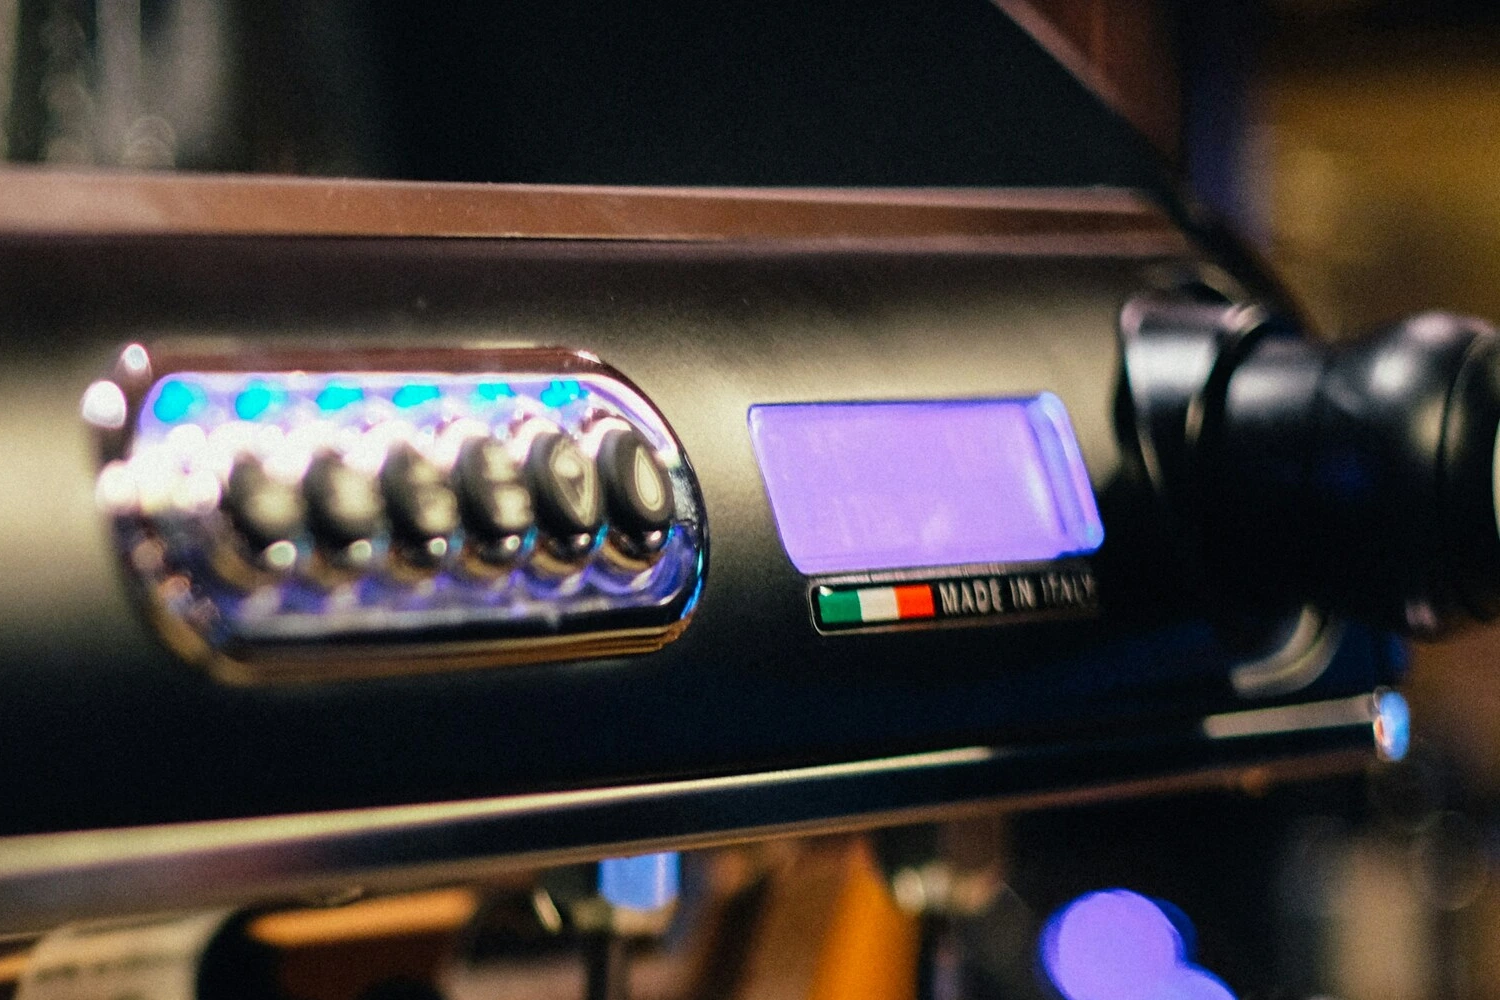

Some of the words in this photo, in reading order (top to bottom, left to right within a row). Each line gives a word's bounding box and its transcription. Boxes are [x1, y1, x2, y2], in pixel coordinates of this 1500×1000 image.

[938, 578, 1004, 615] MADE
[1009, 576, 1037, 609] IN
[1041, 572, 1095, 608] ITALY
